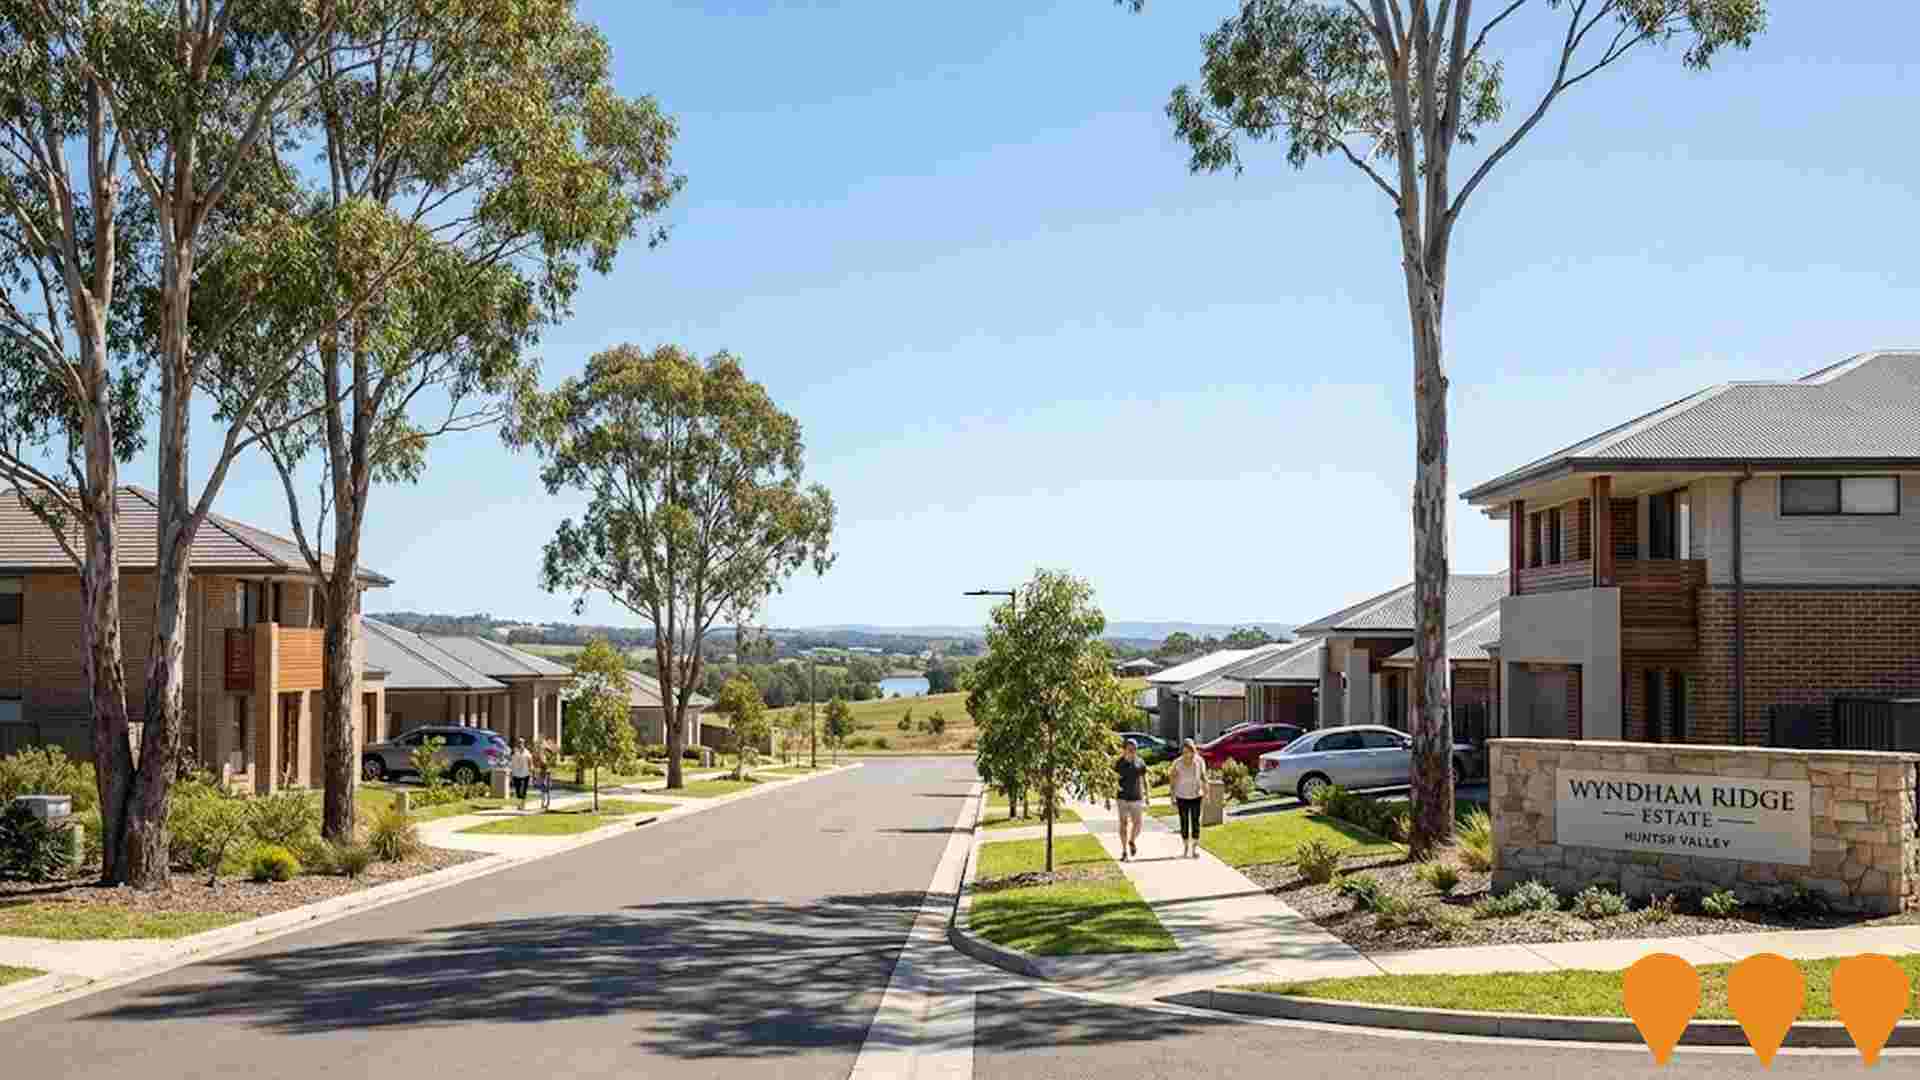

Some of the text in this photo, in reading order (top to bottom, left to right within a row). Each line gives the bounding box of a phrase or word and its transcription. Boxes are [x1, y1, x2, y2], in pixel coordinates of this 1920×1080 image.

[1569, 780, 1795, 811] WYNDHAM RIDGE
[1642, 808, 1713, 828] ESTATE
[1680, 834, 1730, 849] VALLEY
